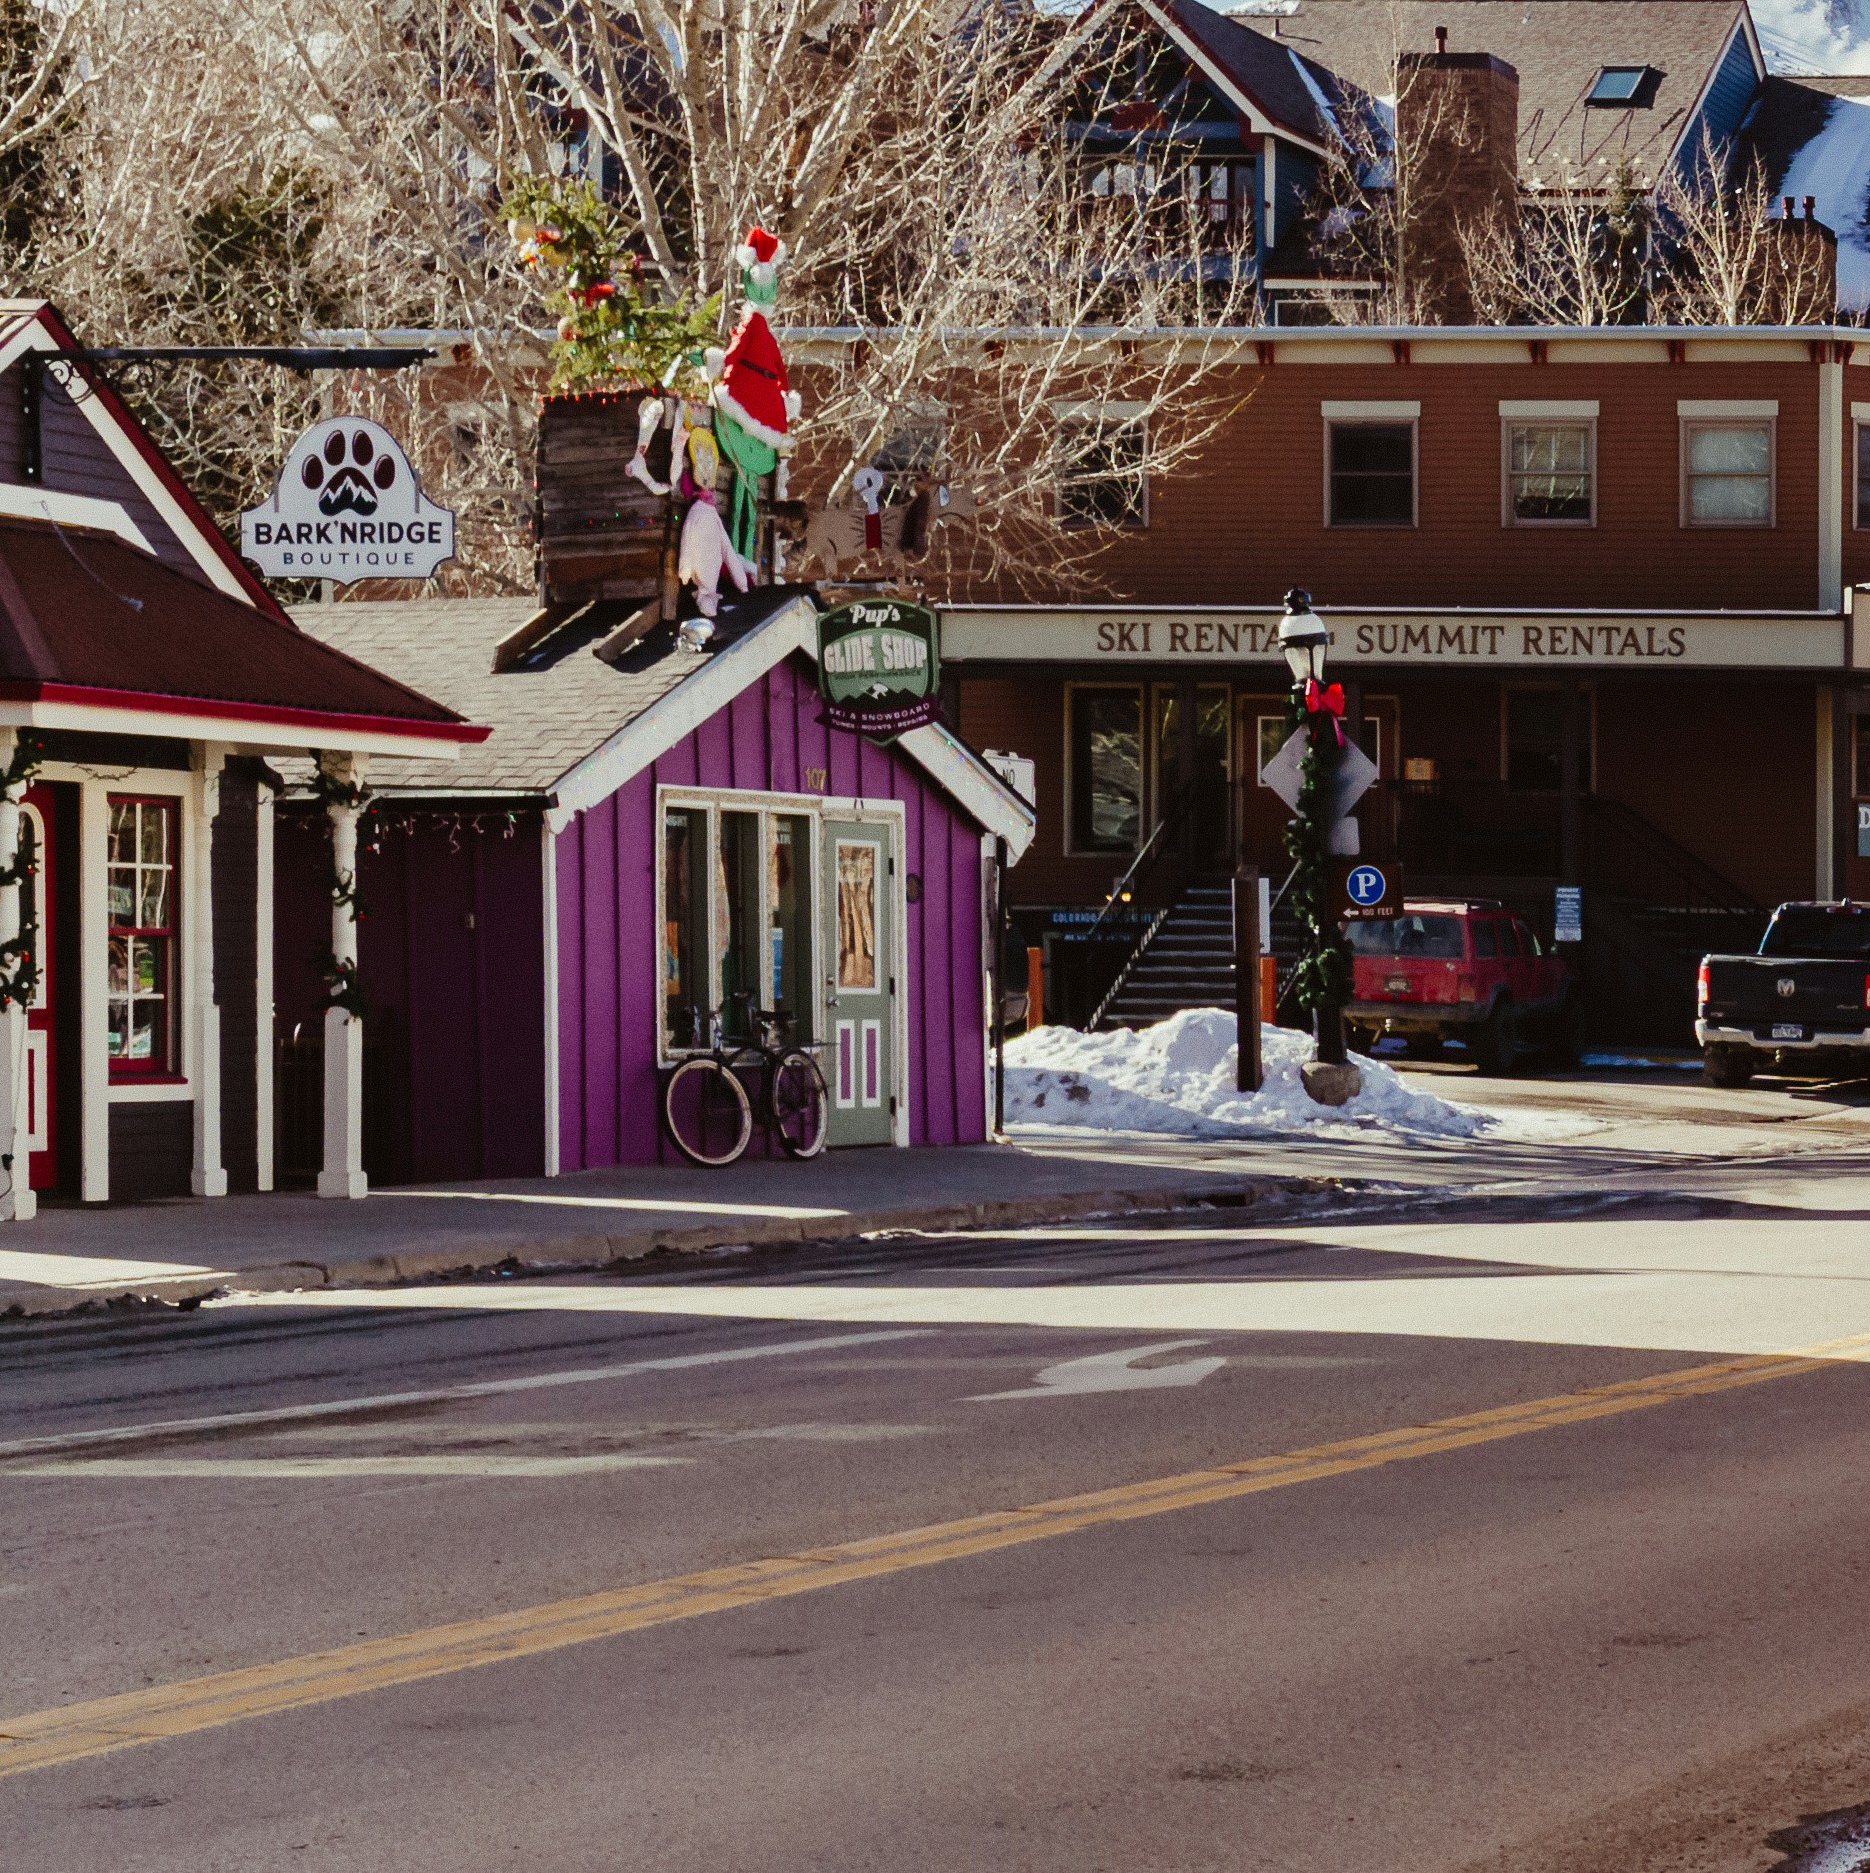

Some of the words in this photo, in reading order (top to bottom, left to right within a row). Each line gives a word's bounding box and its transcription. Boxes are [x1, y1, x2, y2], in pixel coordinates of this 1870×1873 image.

[254, 520, 442, 545] BARK'NRIDGE
[283, 552, 414, 565] BOUTIQUE
[849, 604, 901, 628] Pup's
[1097, 622, 1152, 653] SKI
[1356, 624, 1505, 655] SUMMIT
[1522, 625, 1686, 657] RENTALS
[824, 635, 876, 673] GLIDE
[881, 633, 928, 670] SHOP
[829, 707, 846, 718] SKI
[861, 702, 930, 722] SNOWBOARD
[805, 767, 827, 791] 107
[1355, 873, 1376, 897] P
[1377, 907, 1394, 916] FEET
